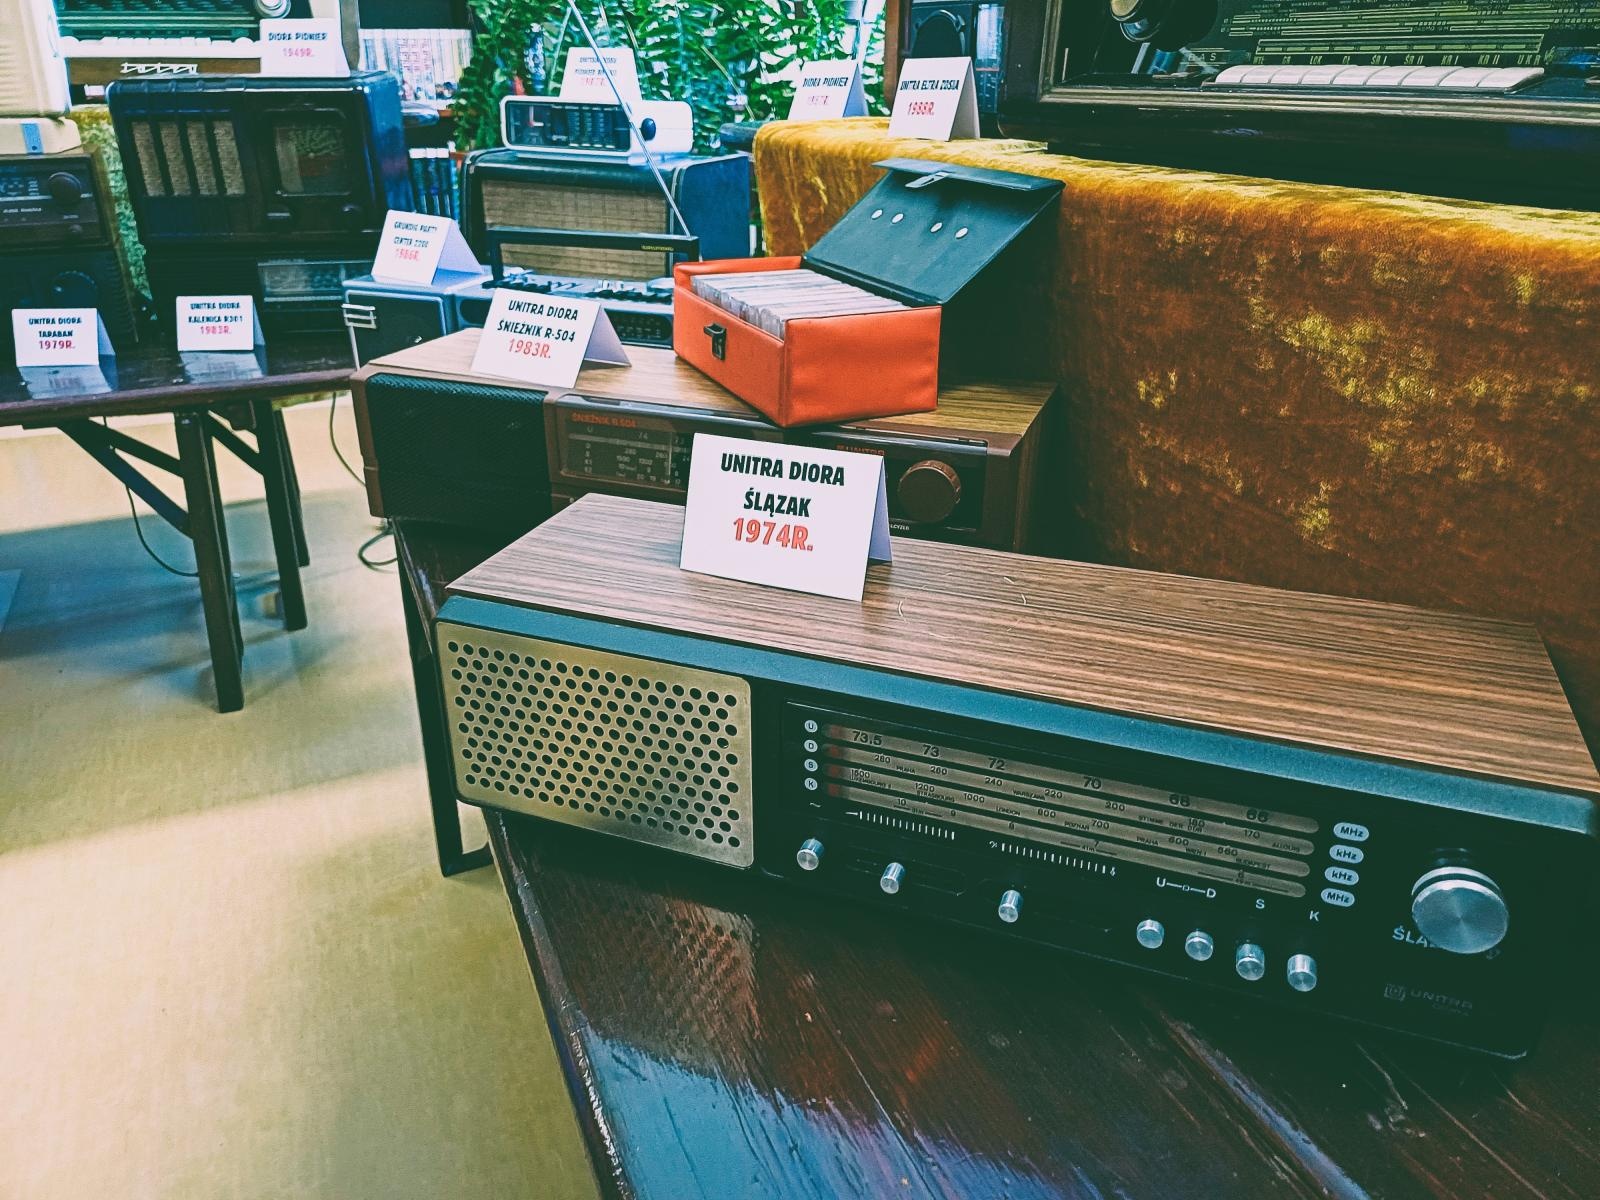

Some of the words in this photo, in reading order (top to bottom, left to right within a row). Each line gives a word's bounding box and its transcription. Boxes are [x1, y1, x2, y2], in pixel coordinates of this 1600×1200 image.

[268, 32, 292, 41] DIORA
[295, 32, 328, 40] PIONIER
[900, 80, 920, 90] UNITRA
[190, 302, 216, 310] UNITRA
[219, 302, 241, 310] DIORA
[508, 300, 544, 316] UNITRA
[547, 306, 578, 321] DIORA
[38, 330, 73, 338] TARABAN
[200, 325, 232, 335] 1983R.
[497, 318, 542, 337] ŚNIEŻNIK
[544, 328, 576, 342] R-504
[39, 340, 76, 350] 1979R.
[508, 338, 551, 358] 1983R.
[721, 452, 783, 478] UNITRA
[789, 461, 845, 486] DIORA
[743, 487, 811, 517] ŚLĄZAK
[733, 517, 813, 551] 1974R.
[852, 730, 882, 746] 73.5
[922, 745, 940, 758] 73
[988, 757, 1005, 770] 72
[1083, 777, 1102, 790] 70
[1169, 793, 1190, 807] 68
[874, 754, 891, 764] 280
[930, 766, 948, 776] 260
[985, 777, 1002, 787] 240
[1044, 789, 1062, 799] 220
[1105, 801, 1125, 812] 200
[1244, 829, 1260, 840] 170
[897, 799, 906, 807] 10
[915, 782, 935, 793] 1200
[964, 793, 985, 803] 1000
[1092, 820, 1110, 830] 700
[1340, 826, 1364, 838] MHz
[1336, 847, 1357, 860] kHz
[1332, 870, 1353, 881] kHz
[1156, 876, 1166, 887] U
[1206, 888, 1216, 898] D
[1327, 892, 1349, 903] MHz
[1255, 899, 1265, 909] S
[1309, 911, 1320, 922] K
